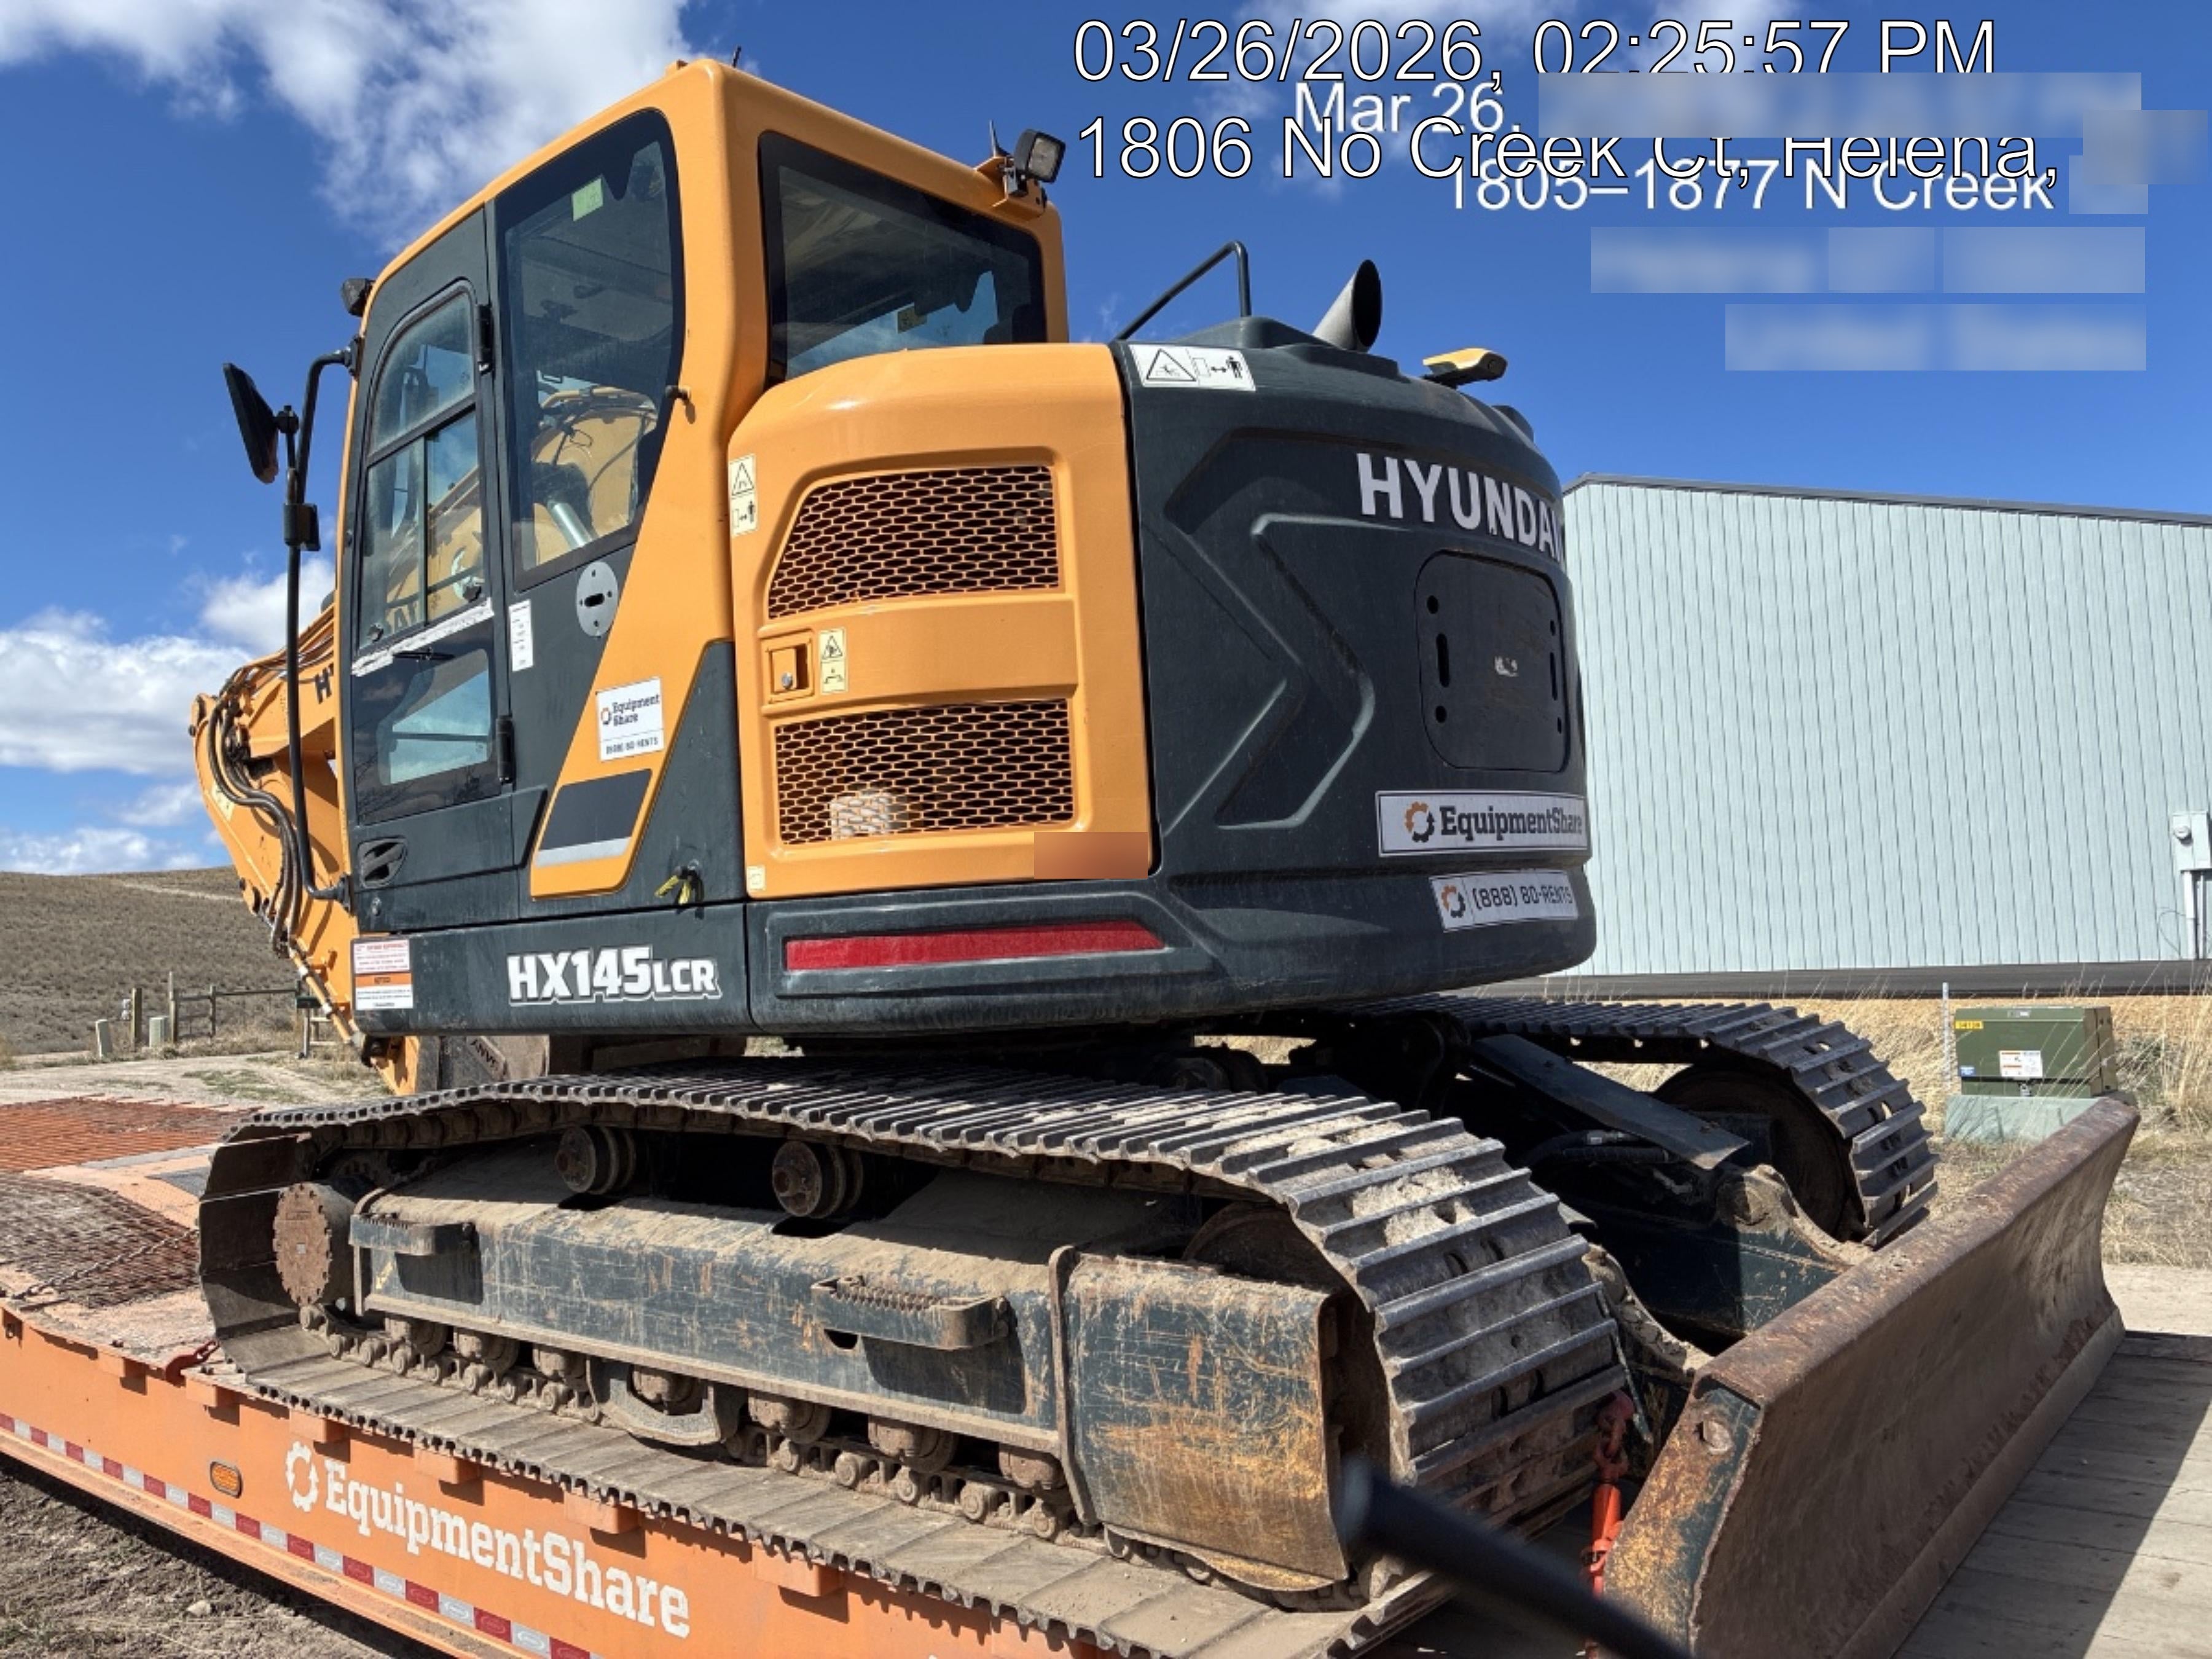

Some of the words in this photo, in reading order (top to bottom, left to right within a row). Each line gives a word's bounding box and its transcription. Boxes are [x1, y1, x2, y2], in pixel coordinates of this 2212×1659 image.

[1439, 806, 1582, 842] EquipmentShare
[1472, 884, 1518, 911] (888)
[324, 1457, 691, 1639] EquipmentShare
